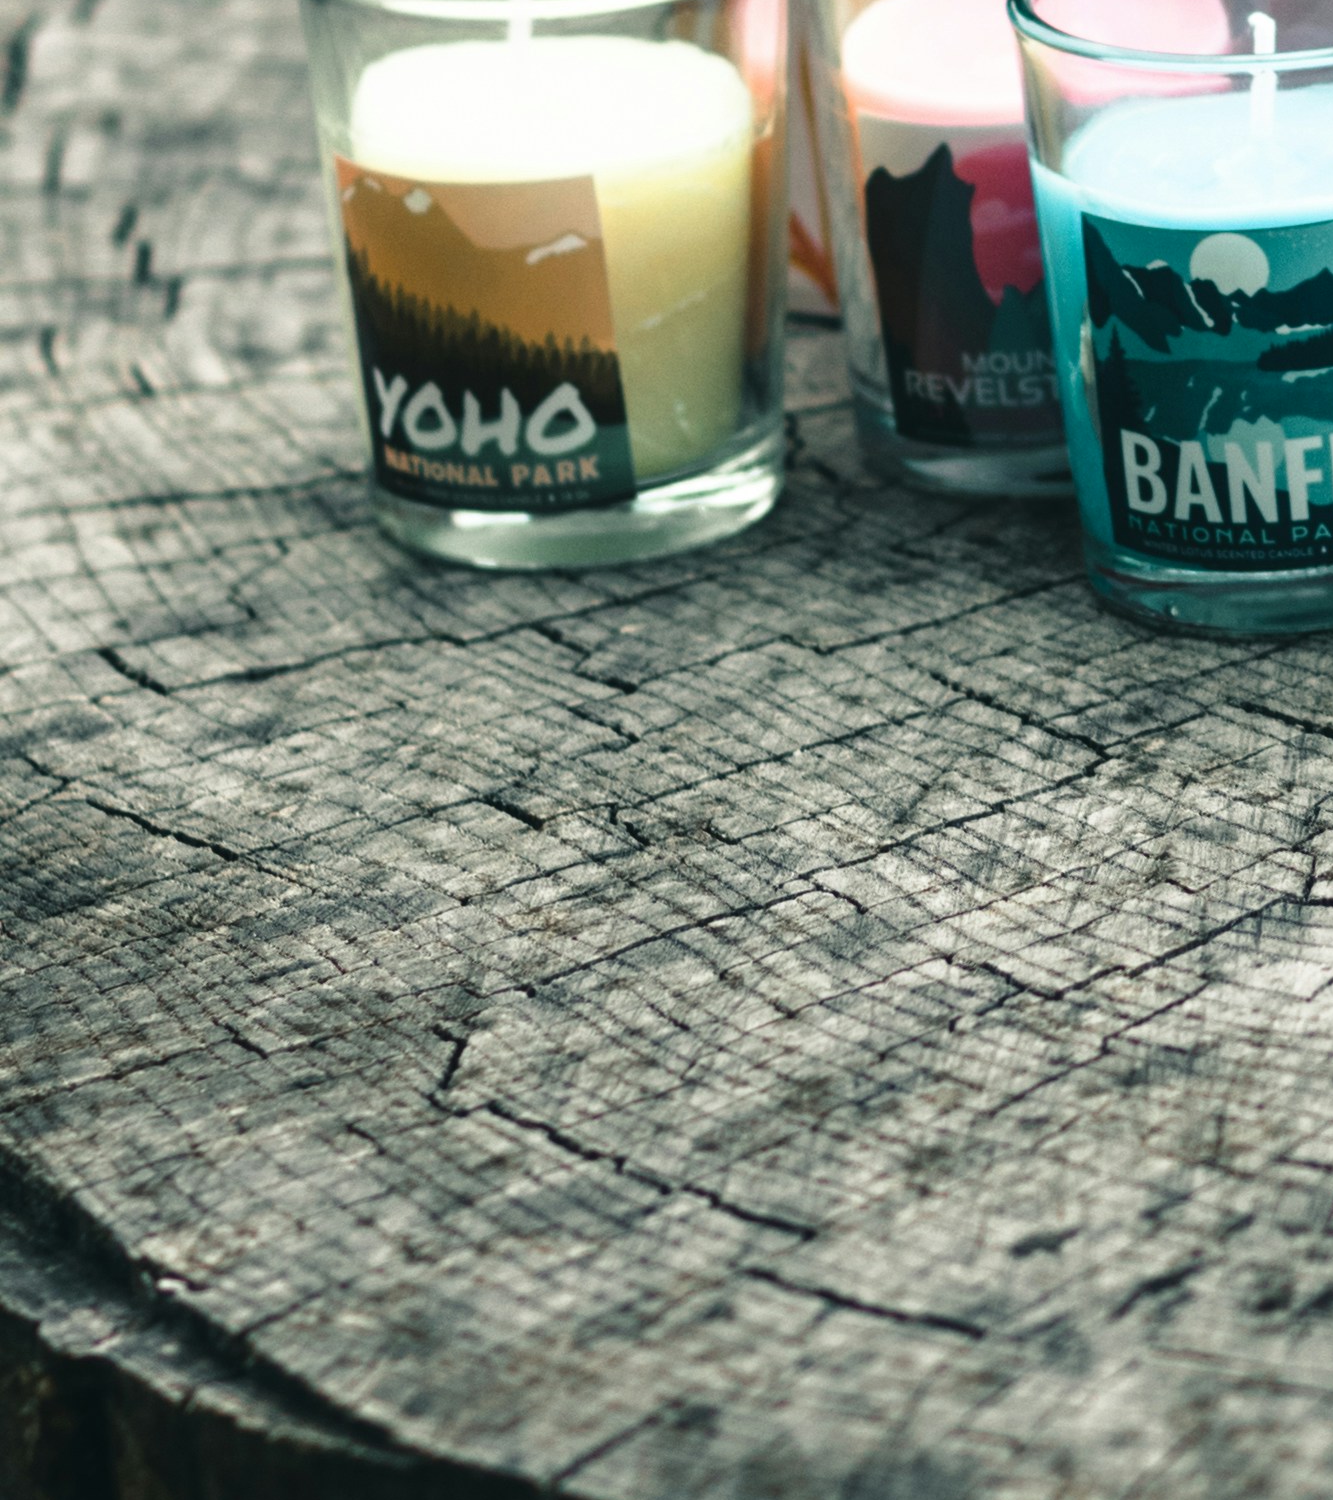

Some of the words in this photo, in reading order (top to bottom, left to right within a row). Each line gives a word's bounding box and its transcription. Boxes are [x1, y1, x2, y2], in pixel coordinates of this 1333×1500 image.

[373, 366, 597, 455] YOHO
[384, 444, 498, 487] NATIONAL
[512, 455, 600, 487] PARK
[1128, 514, 1275, 545] NATIONAL
[1268, 546, 1314, 560] CANDLE
